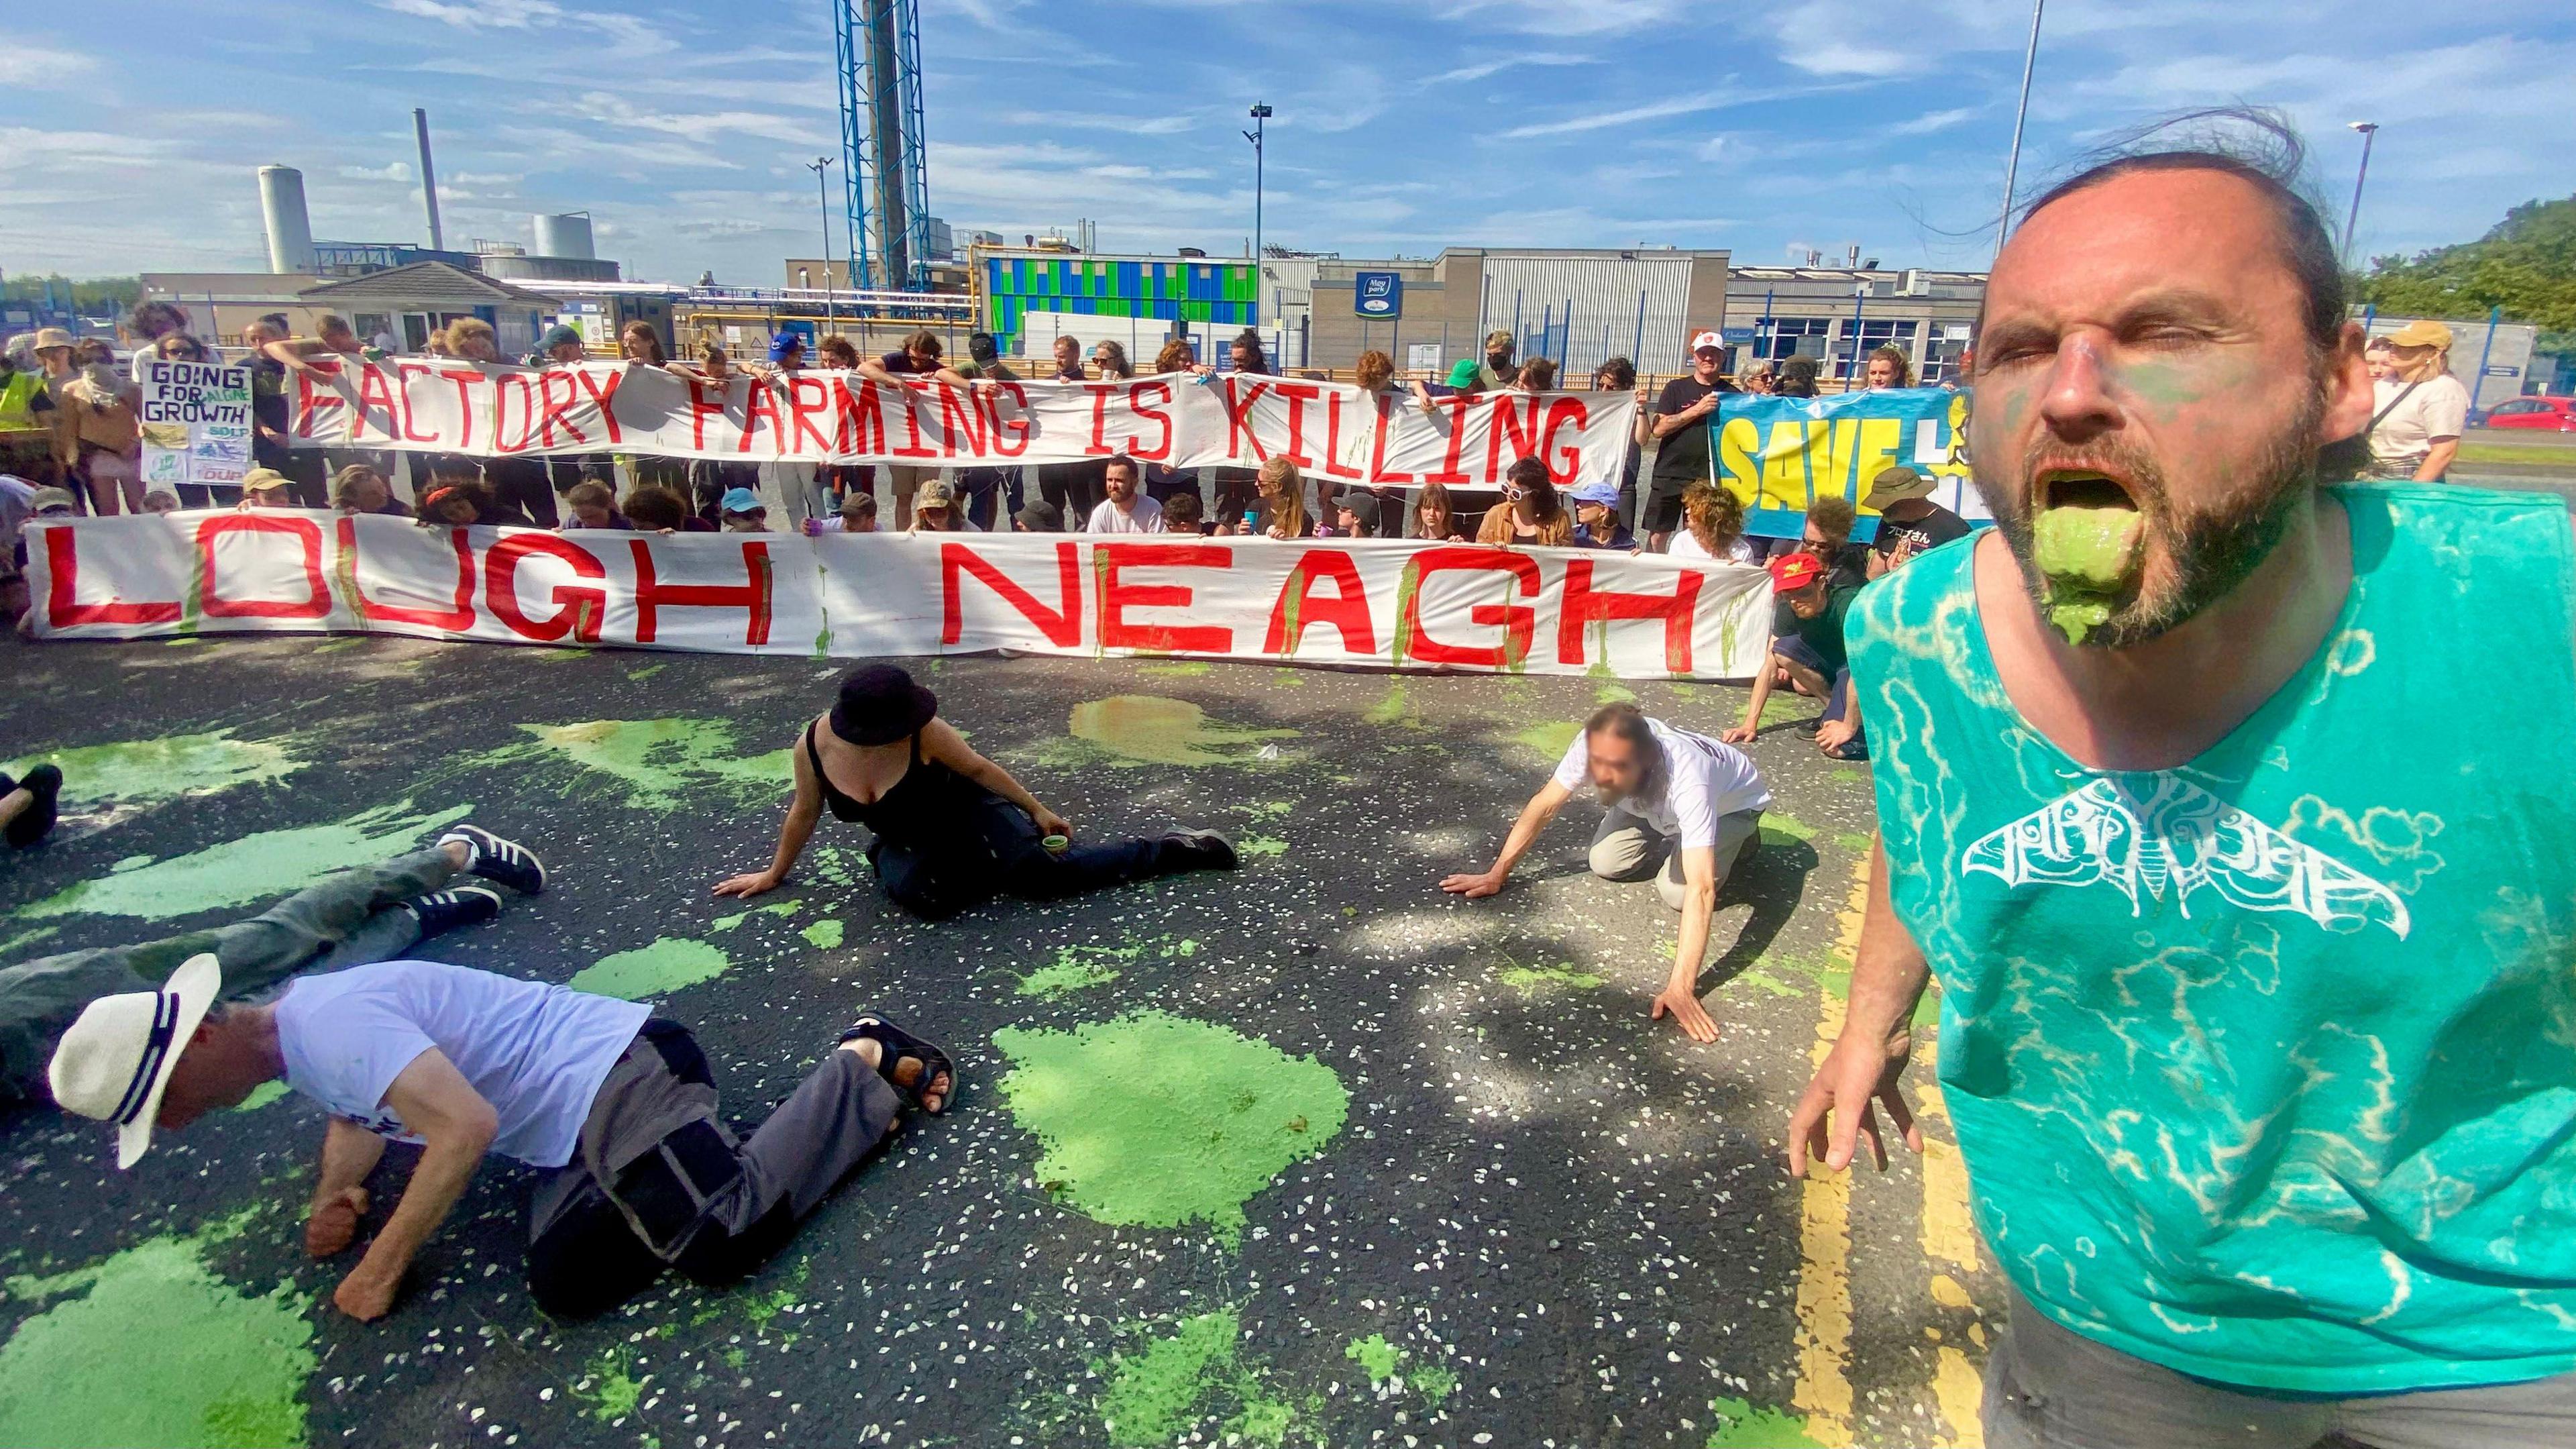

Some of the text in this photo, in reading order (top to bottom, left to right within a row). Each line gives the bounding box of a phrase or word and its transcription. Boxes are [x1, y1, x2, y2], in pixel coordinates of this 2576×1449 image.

[1368, 286, 1385, 294] park
[1369, 279, 1386, 288] Moy
[158, 384, 202, 402] FOR
[298, 361, 1588, 486] FACTORY FARMING IS KILLING
[1719, 416, 1901, 517] SAVE
[46, 515, 1705, 674] LOUGH NEAGH
